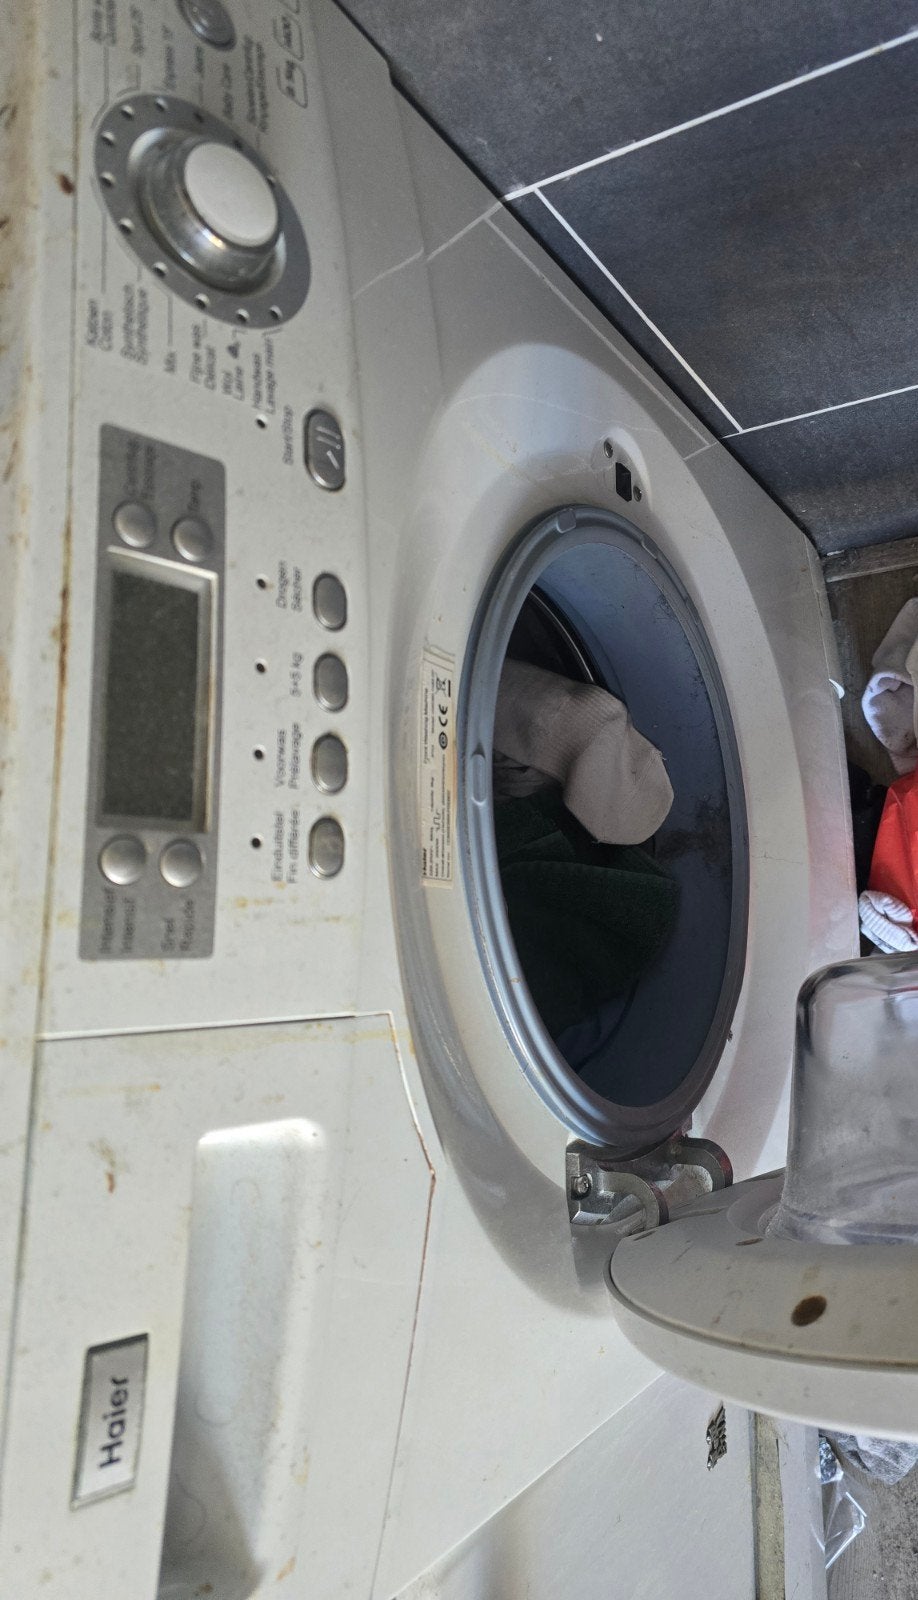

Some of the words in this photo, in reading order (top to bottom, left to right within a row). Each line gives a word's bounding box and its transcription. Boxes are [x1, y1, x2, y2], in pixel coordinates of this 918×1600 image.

[191, 324, 201, 349] was
[233, 366, 245, 401] Laine
[251, 352, 263, 409] Handwas
[264, 371, 278, 415] Lavage
[281, 404, 294, 466] Start/Stop
[275, 560, 289, 609] Drogen
[273, 727, 286, 787] Voorwas
[286, 862, 299, 884] Fin
[97, 1376, 130, 1469] Haier
